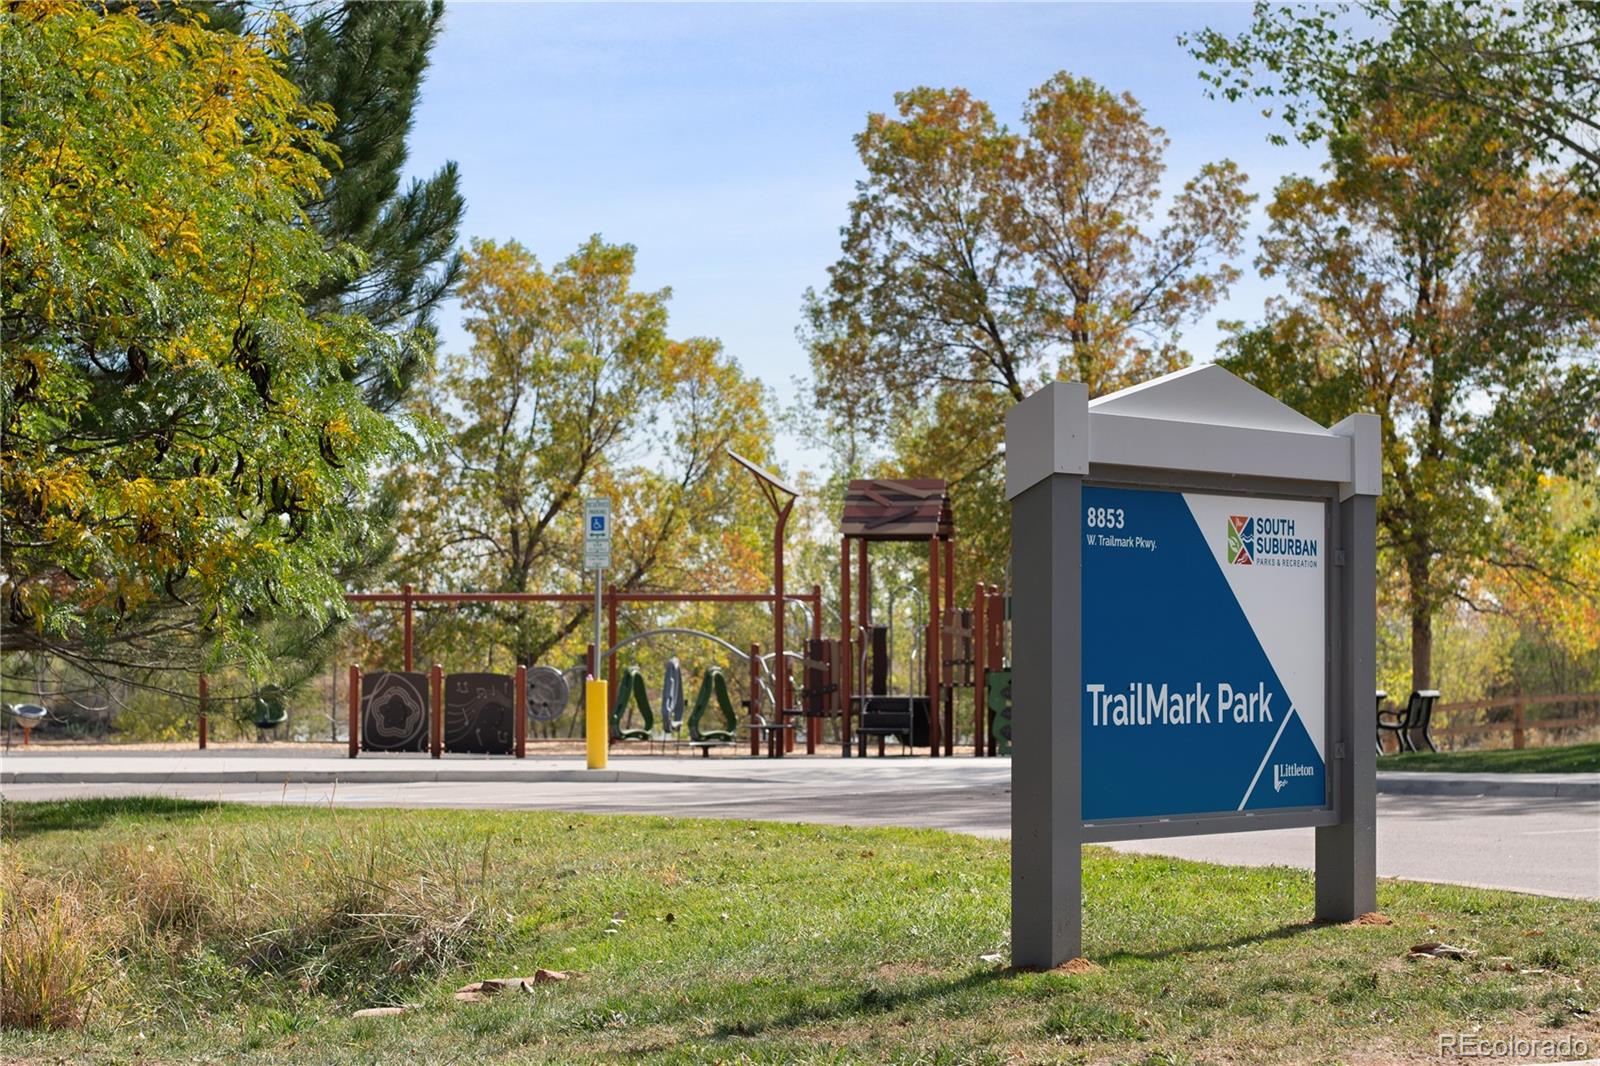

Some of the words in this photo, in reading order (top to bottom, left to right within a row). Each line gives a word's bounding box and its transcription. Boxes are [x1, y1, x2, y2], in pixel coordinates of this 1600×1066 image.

[1087, 506, 1125, 529] 8853
[1256, 518, 1295, 536] SOUTH
[1086, 533, 1097, 546] W.
[1098, 534, 1135, 548] Trailmark
[1135, 536, 1157, 552] Pkwy.
[1256, 537, 1318, 556] SUBURBAN
[1256, 558, 1276, 567] PARKS
[1282, 559, 1318, 568] RECREATION
[1086, 682, 1211, 726] TrailMark
[1218, 682, 1273, 724] Park
[1280, 763, 1314, 777] Littleton
